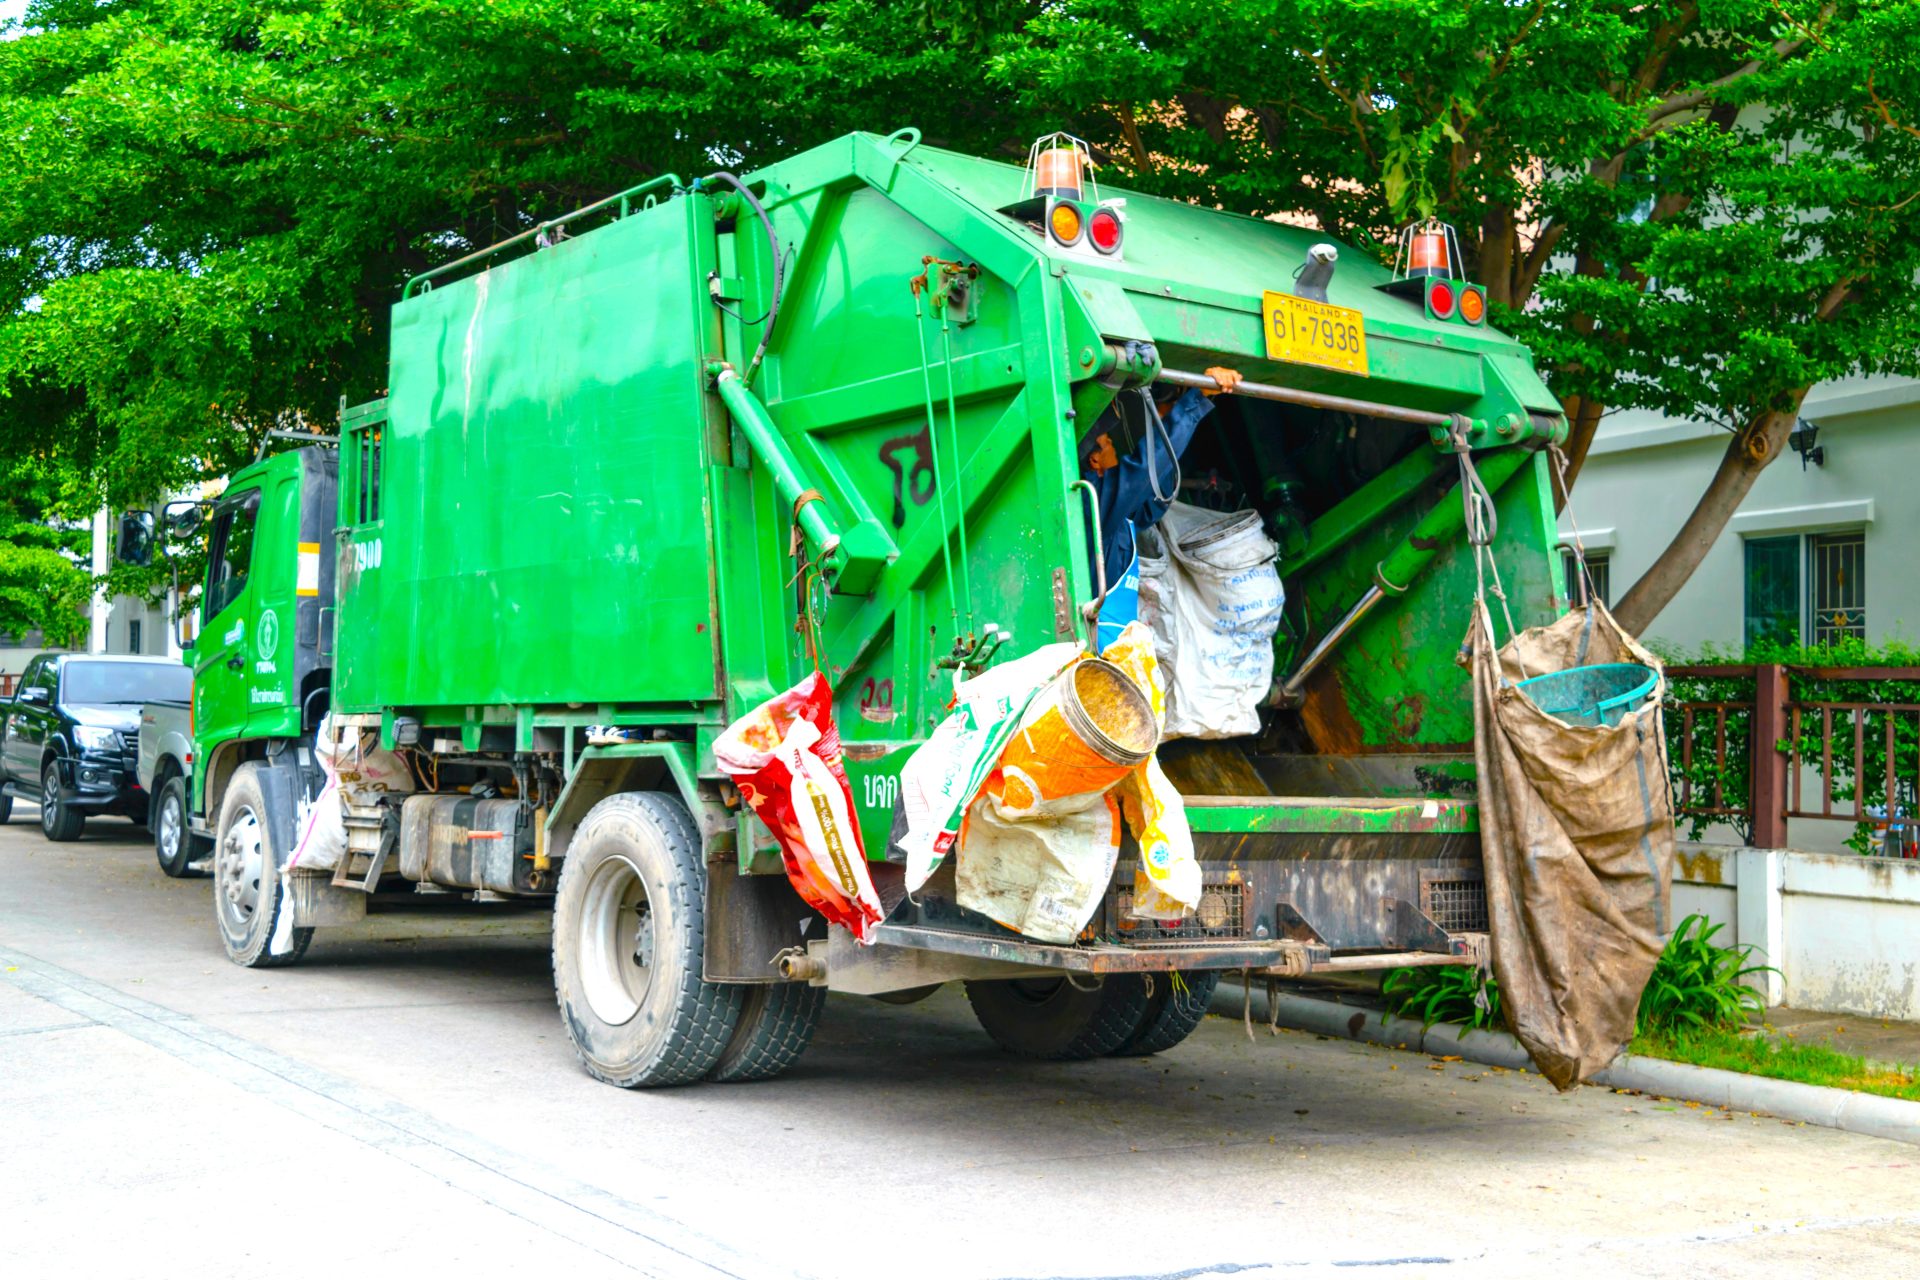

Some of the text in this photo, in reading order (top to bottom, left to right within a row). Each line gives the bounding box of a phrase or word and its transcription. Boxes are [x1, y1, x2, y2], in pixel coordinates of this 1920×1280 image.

[1289, 300, 1340, 318] THAILAND
[1273, 309, 1359, 354] 61-7936
[820, 809, 832, 832] 100%
[830, 833, 840, 850] Rice
